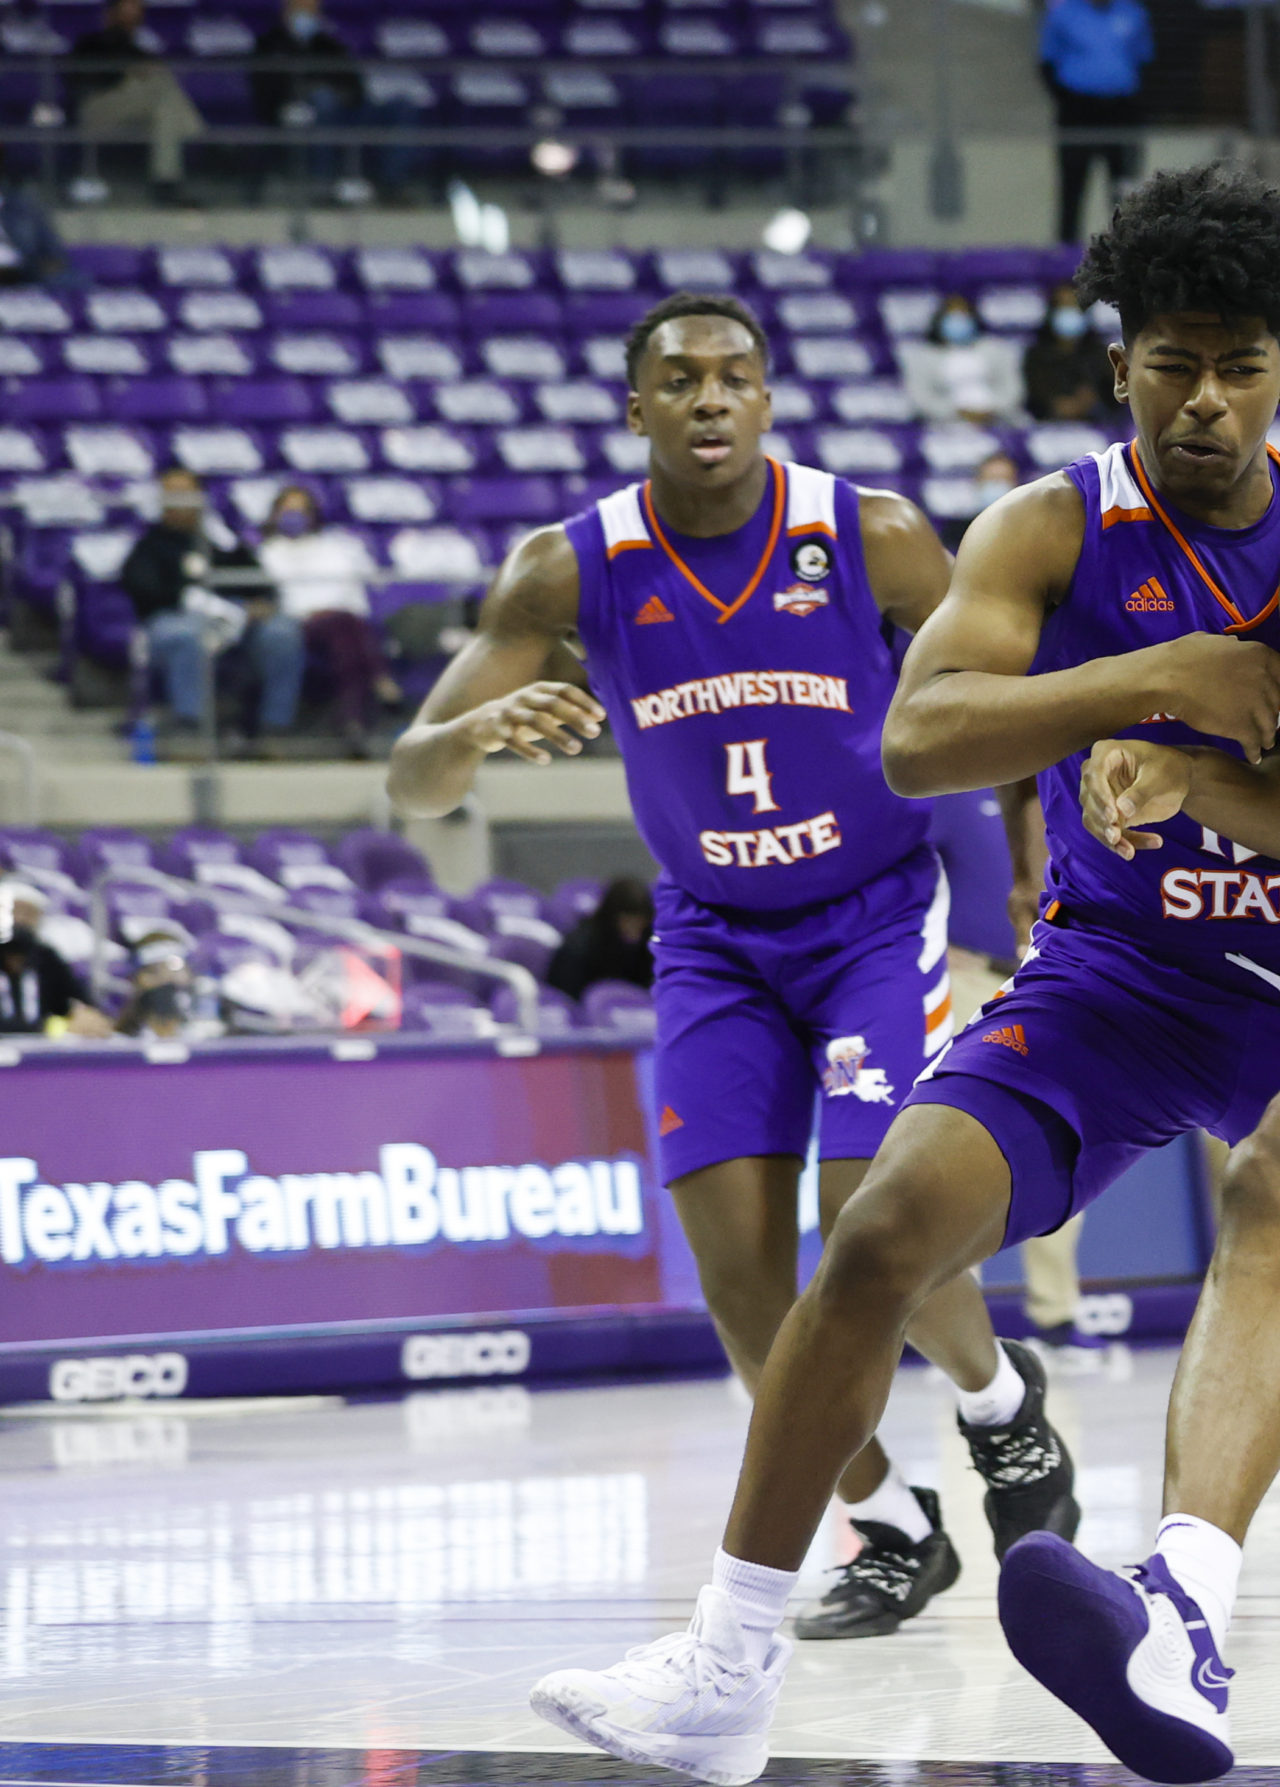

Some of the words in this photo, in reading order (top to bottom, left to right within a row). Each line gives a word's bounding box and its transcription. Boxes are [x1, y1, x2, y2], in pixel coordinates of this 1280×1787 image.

[1125, 598, 1175, 612] adidas
[630, 670, 853, 730] NORTHWESTERN
[724, 738, 781, 814] 4
[699, 811, 842, 868] STATE
[50, 1352, 188, 1401] GEICO
[404, 1330, 530, 1379] GEICO
